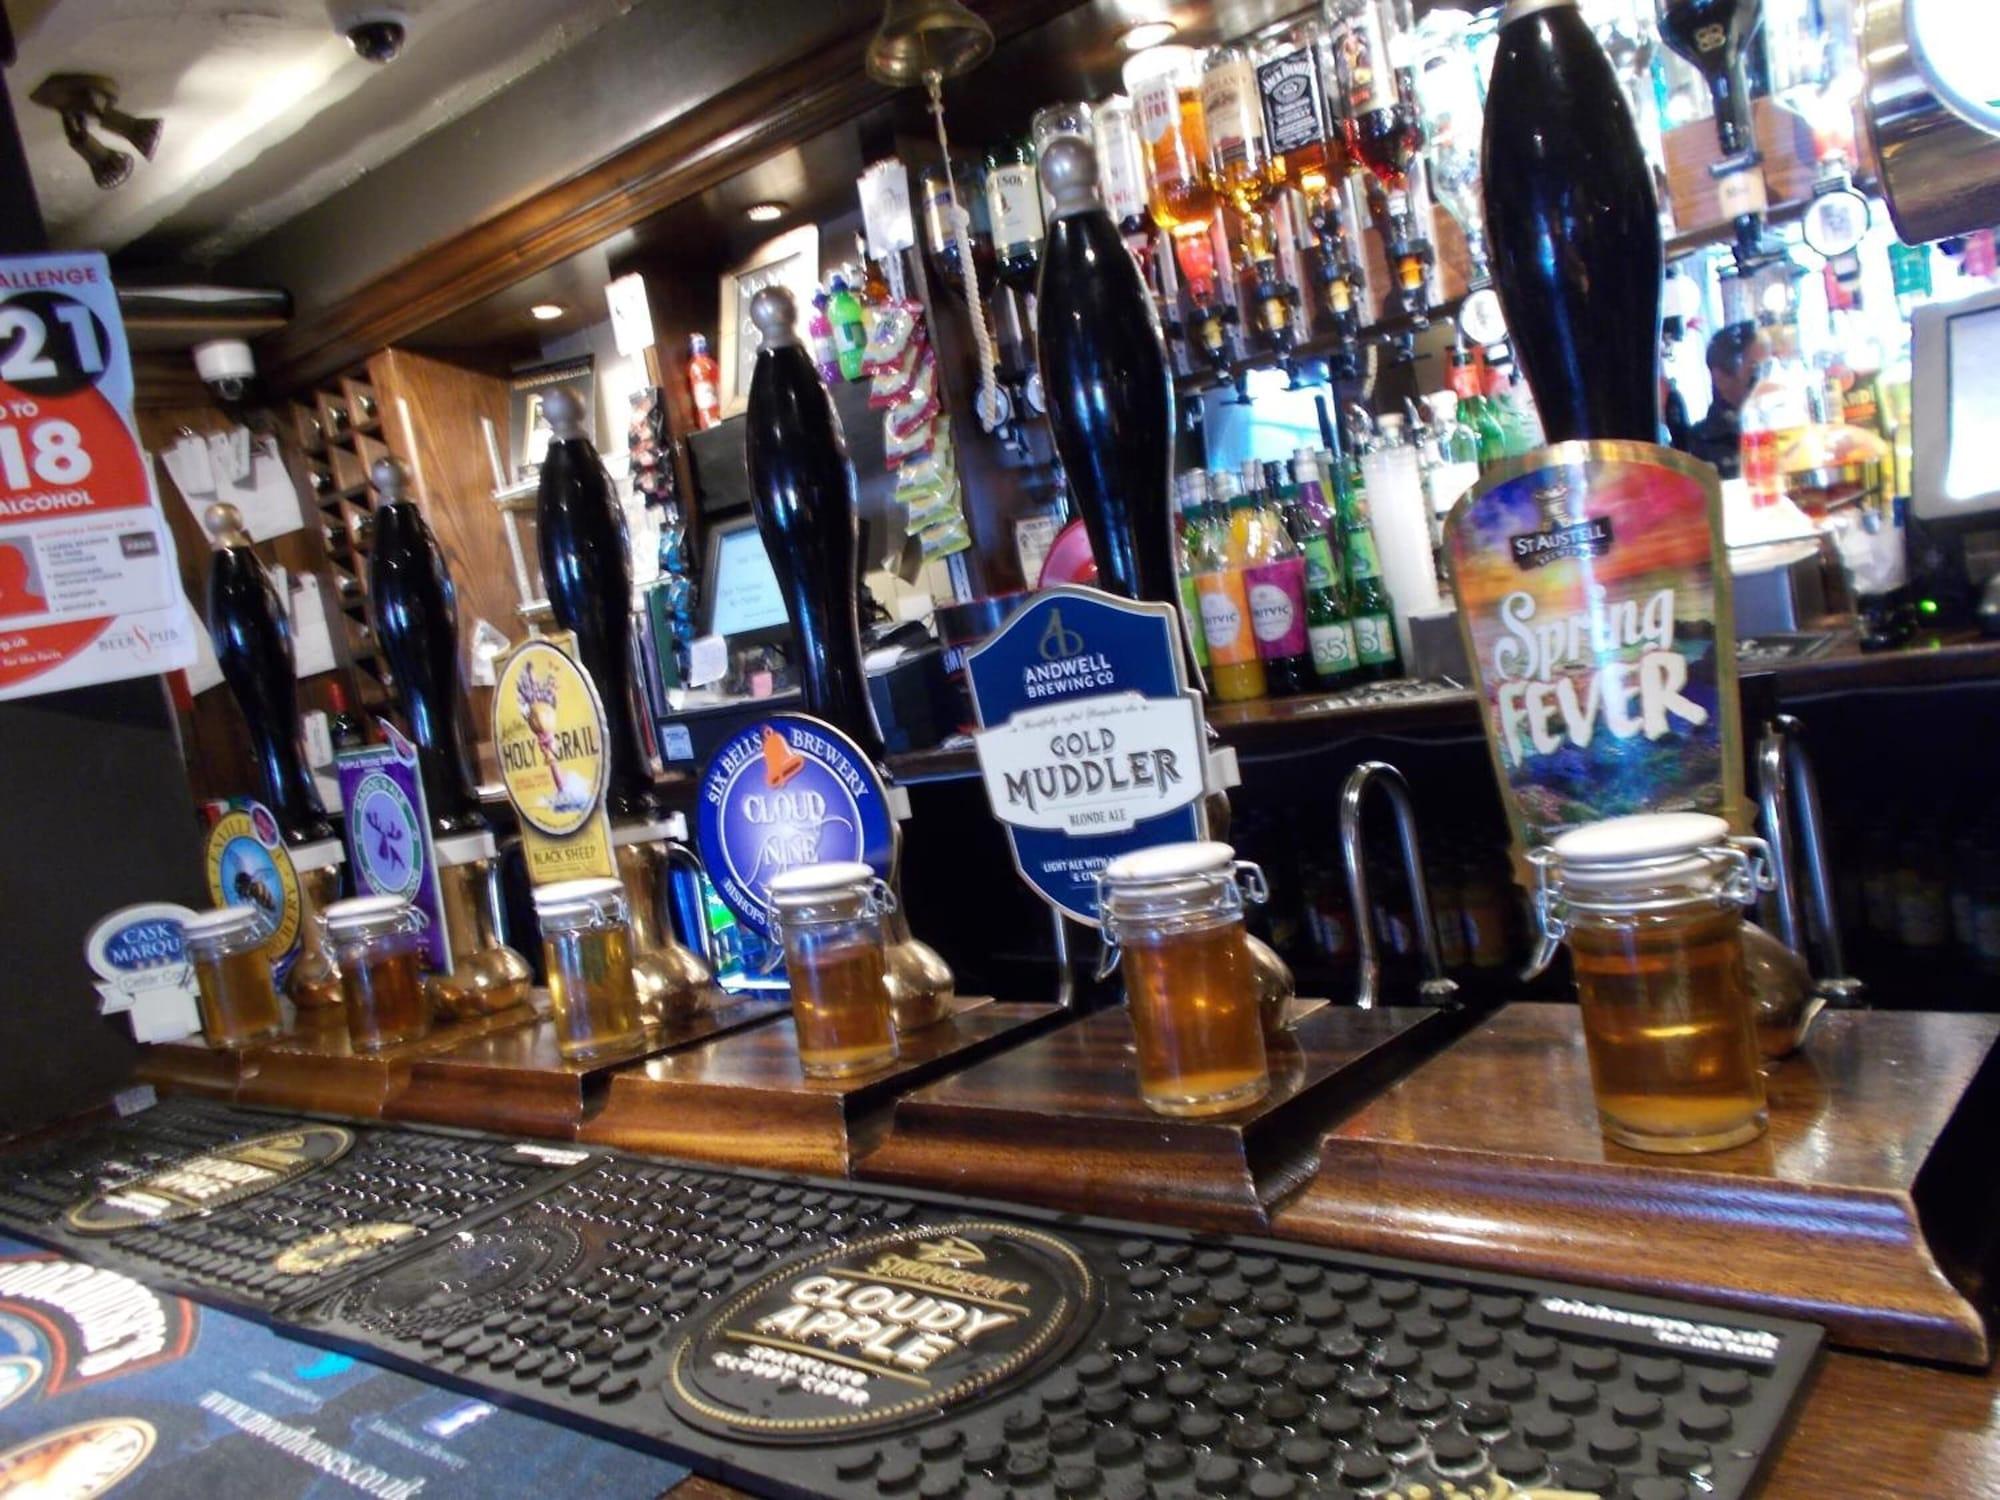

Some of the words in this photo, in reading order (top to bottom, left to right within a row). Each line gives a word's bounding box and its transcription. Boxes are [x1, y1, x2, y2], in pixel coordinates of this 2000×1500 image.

[0, 303, 105, 381] 21
[10, 400, 39, 419] TO
[0, 419, 93, 491] 18
[0, 490, 95, 514] ALCOHOL
[1494, 583, 1675, 681] Spring
[1026, 652, 1112, 683] ANDWELL
[1027, 675, 1095, 698] BREWING
[1498, 648, 1709, 768] FEVER
[502, 741, 537, 775] HOLY
[554, 725, 599, 761] GRAIL
[1050, 728, 1116, 759] GOLD
[708, 769, 729, 807] SIX
[723, 731, 763, 774] BELLS
[790, 727, 869, 799] BREWERY
[1003, 748, 1184, 814] MUDDLER
[743, 790, 826, 825] CLOUD
[1069, 809, 1105, 827] BLONDE
[1109, 808, 1127, 822] ALE
[566, 845, 597, 863] SHEEP
[1043, 861, 1067, 873] LIGHT
[1069, 858, 1084, 871] ALE
[122, 923, 171, 944] CASK
[111, 937, 180, 964] MARQU
[790, 1275, 1018, 1342] CLOUDY
[753, 1305, 957, 1371] APPLE
